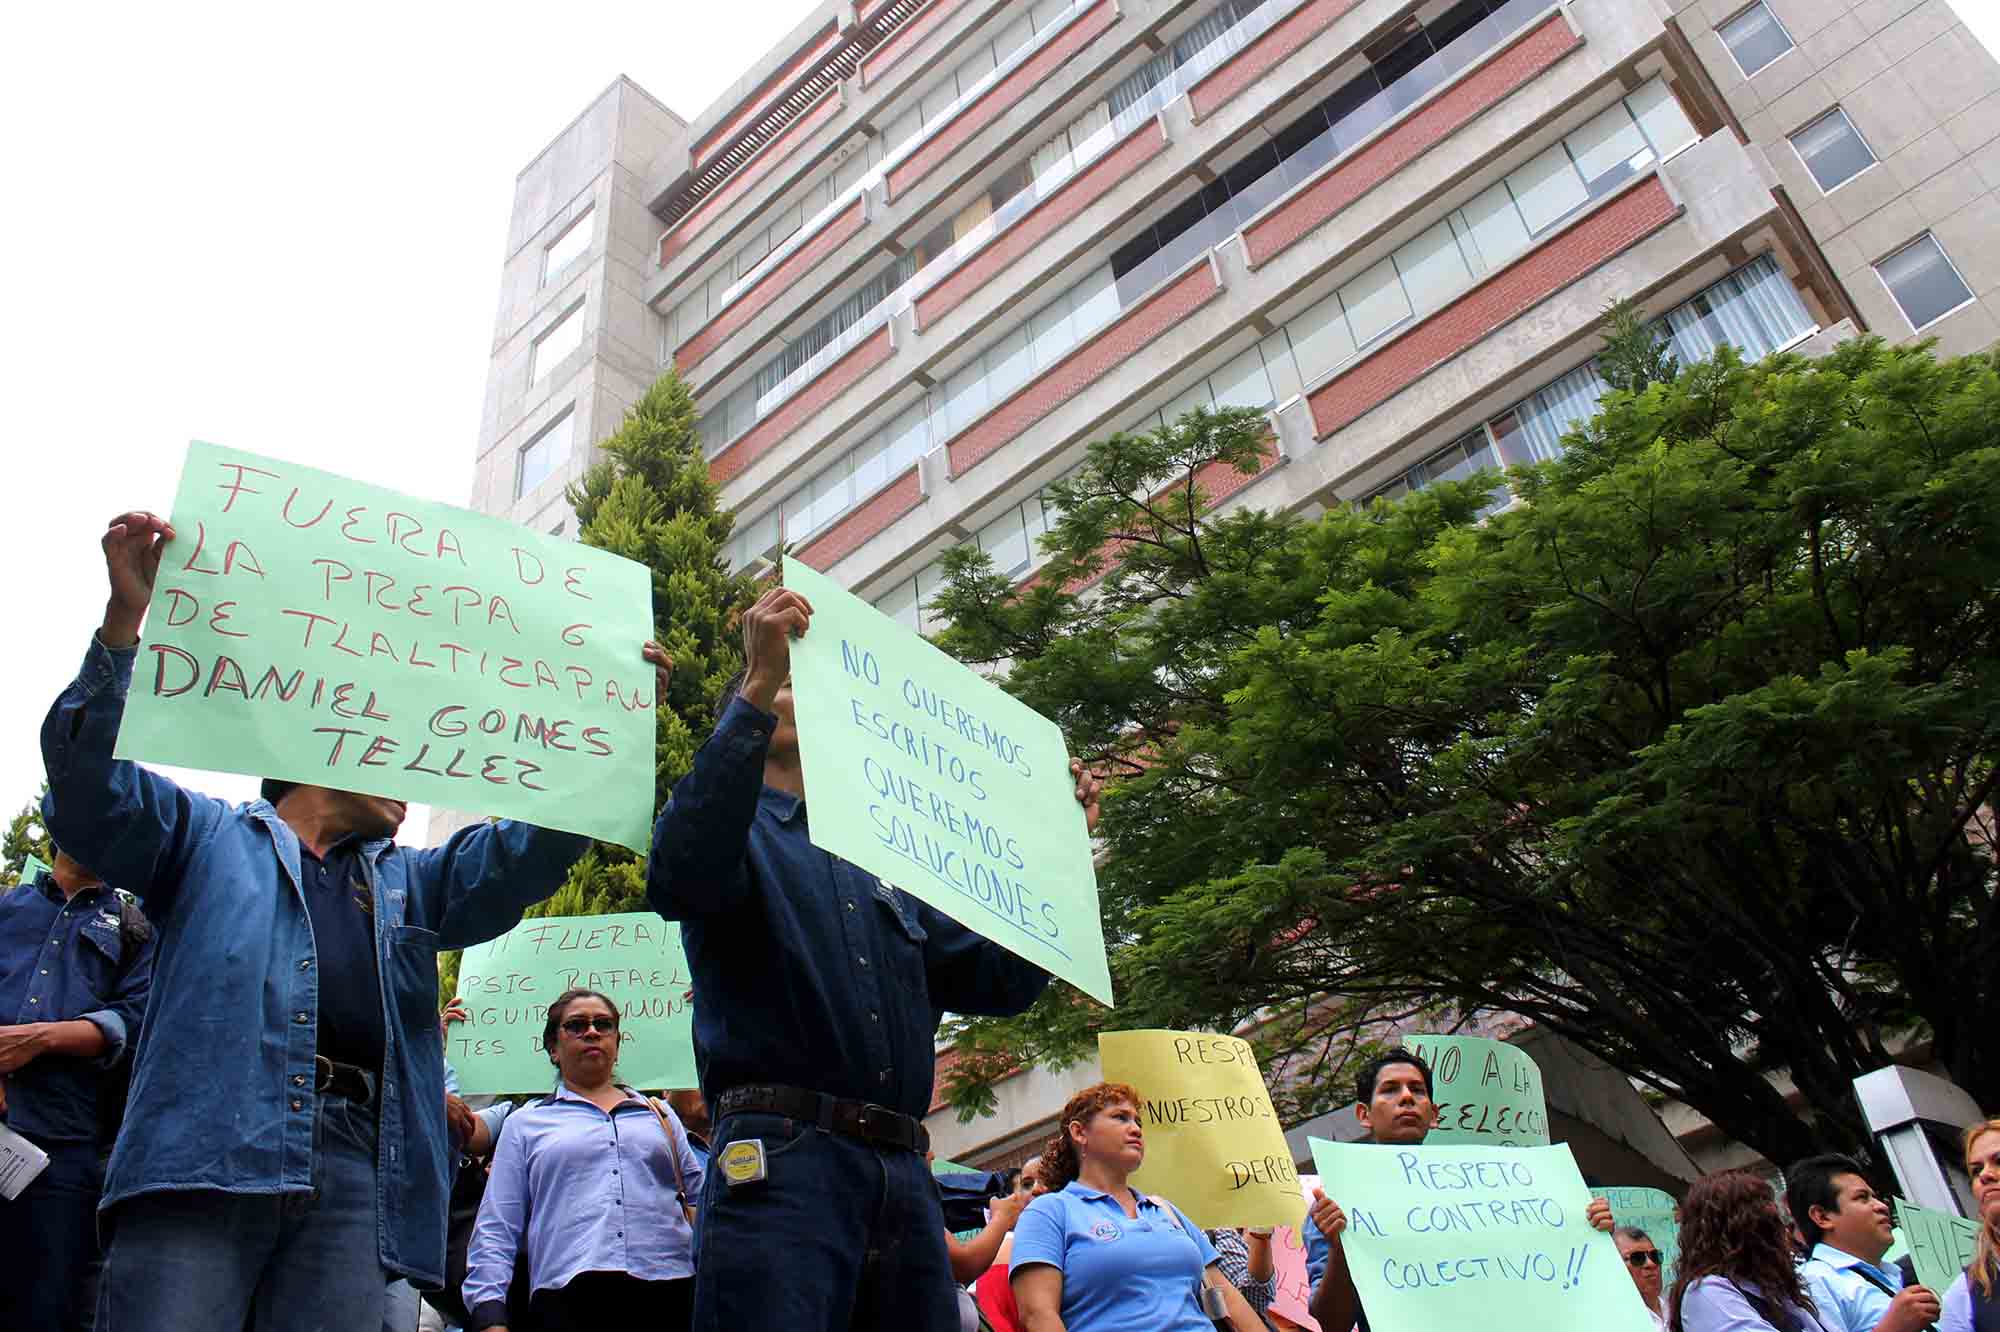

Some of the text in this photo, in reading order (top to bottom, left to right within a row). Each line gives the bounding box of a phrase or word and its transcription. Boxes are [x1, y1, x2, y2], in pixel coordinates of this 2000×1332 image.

[182, 521, 266, 580] LA
[311, 558, 521, 634] PREPA
[218, 462, 592, 601] FUERA DE
[164, 589, 249, 637] DE
[149, 643, 614, 757] DANIEL GOMES
[841, 639, 1032, 778] NO QUEREMOS
[863, 756, 1024, 870] QUEREMOS
[868, 804, 1060, 939] SOLUCIONES
[556, 967, 690, 993] RAFAEL
[1481, 1049, 1503, 1089] A
[1352, 1207, 1390, 1237] AL
[1407, 1198, 1565, 1232] CONTRATO
[1397, 1152, 1533, 1190] RESPETO
